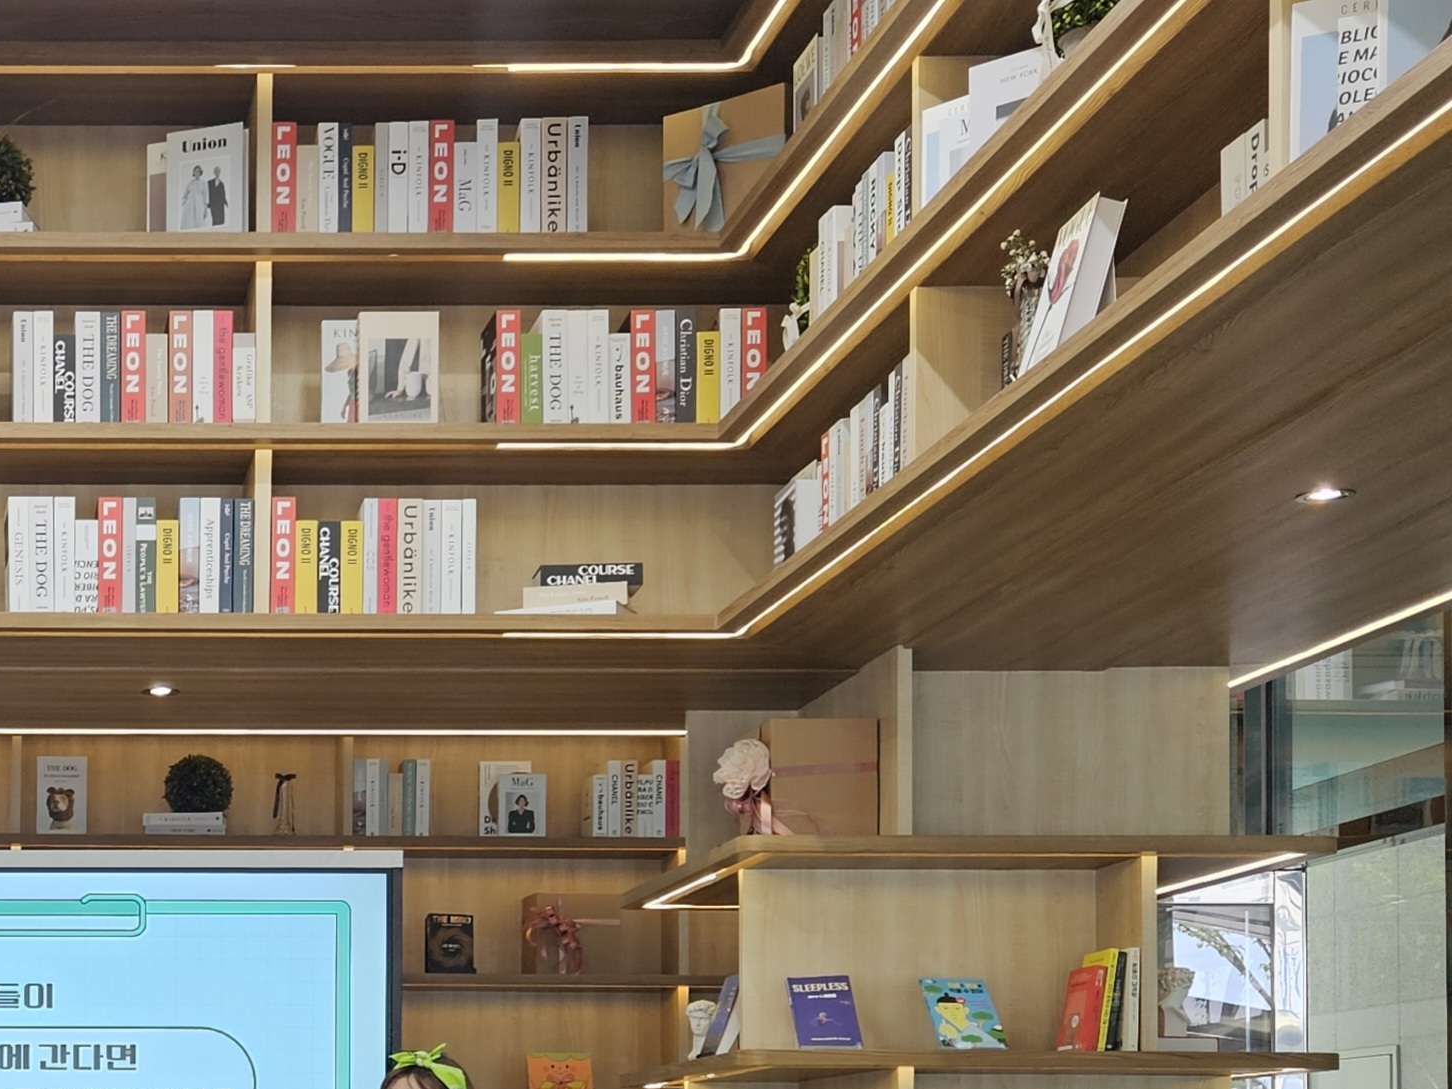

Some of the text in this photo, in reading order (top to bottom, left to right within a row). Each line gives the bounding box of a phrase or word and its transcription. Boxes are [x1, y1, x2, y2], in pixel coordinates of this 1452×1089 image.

[1000, 69, 1038, 84] NEW YORK
[182, 137, 228, 153] Union
[277, 126, 291, 205] LEON
[323, 126, 335, 180] VOGUE
[358, 152, 368, 178] DIGNO
[391, 150, 407, 176] i-D
[433, 124, 448, 203] LEON
[502, 150, 513, 178] DIGNO
[458, 178, 472, 211] MaG
[547, 123, 562, 232] Urbänlike
[106, 315, 117, 380] THE DREAMING
[126, 314, 140, 394] LEON
[173, 314, 187, 394] LEON
[218, 327, 227, 343] the
[501, 314, 515, 393] LEON
[636, 314, 650, 393] LEON
[680, 318, 693, 407] Christian Dior
[705, 339, 713, 366] DIGNO
[747, 311, 761, 389] LEON
[55, 340, 66, 394] CHANEL
[82, 334, 94, 413] THE DOG
[528, 352, 539, 411] harvest
[550, 332, 563, 410] THE DOG
[614, 363, 623, 420] bauhaus
[103, 502, 117, 580] LEON
[163, 528, 172, 555] DIGNO
[239, 501, 251, 566] THE DREAMING
[276, 501, 290, 579] LEON
[301, 528, 310, 554] DIGNO
[348, 529, 357, 556] DIGNO
[383, 516, 391, 531] the
[14, 532, 24, 585] GENESIS
[35, 519, 47, 598] THE DOG
[207, 519, 215, 599] Apprenticeships
[319, 526, 330, 580] CHANEL
[404, 505, 418, 613] Urbänlike
[546, 575, 601, 586] CHANEL
[578, 564, 635, 577] COURSE
[512, 778, 534, 787] MaG
[625, 764, 634, 834] Urbänlike
[792, 982, 849, 993] SLEEPLESS
[39, 1043, 138, 1072] 간다면
